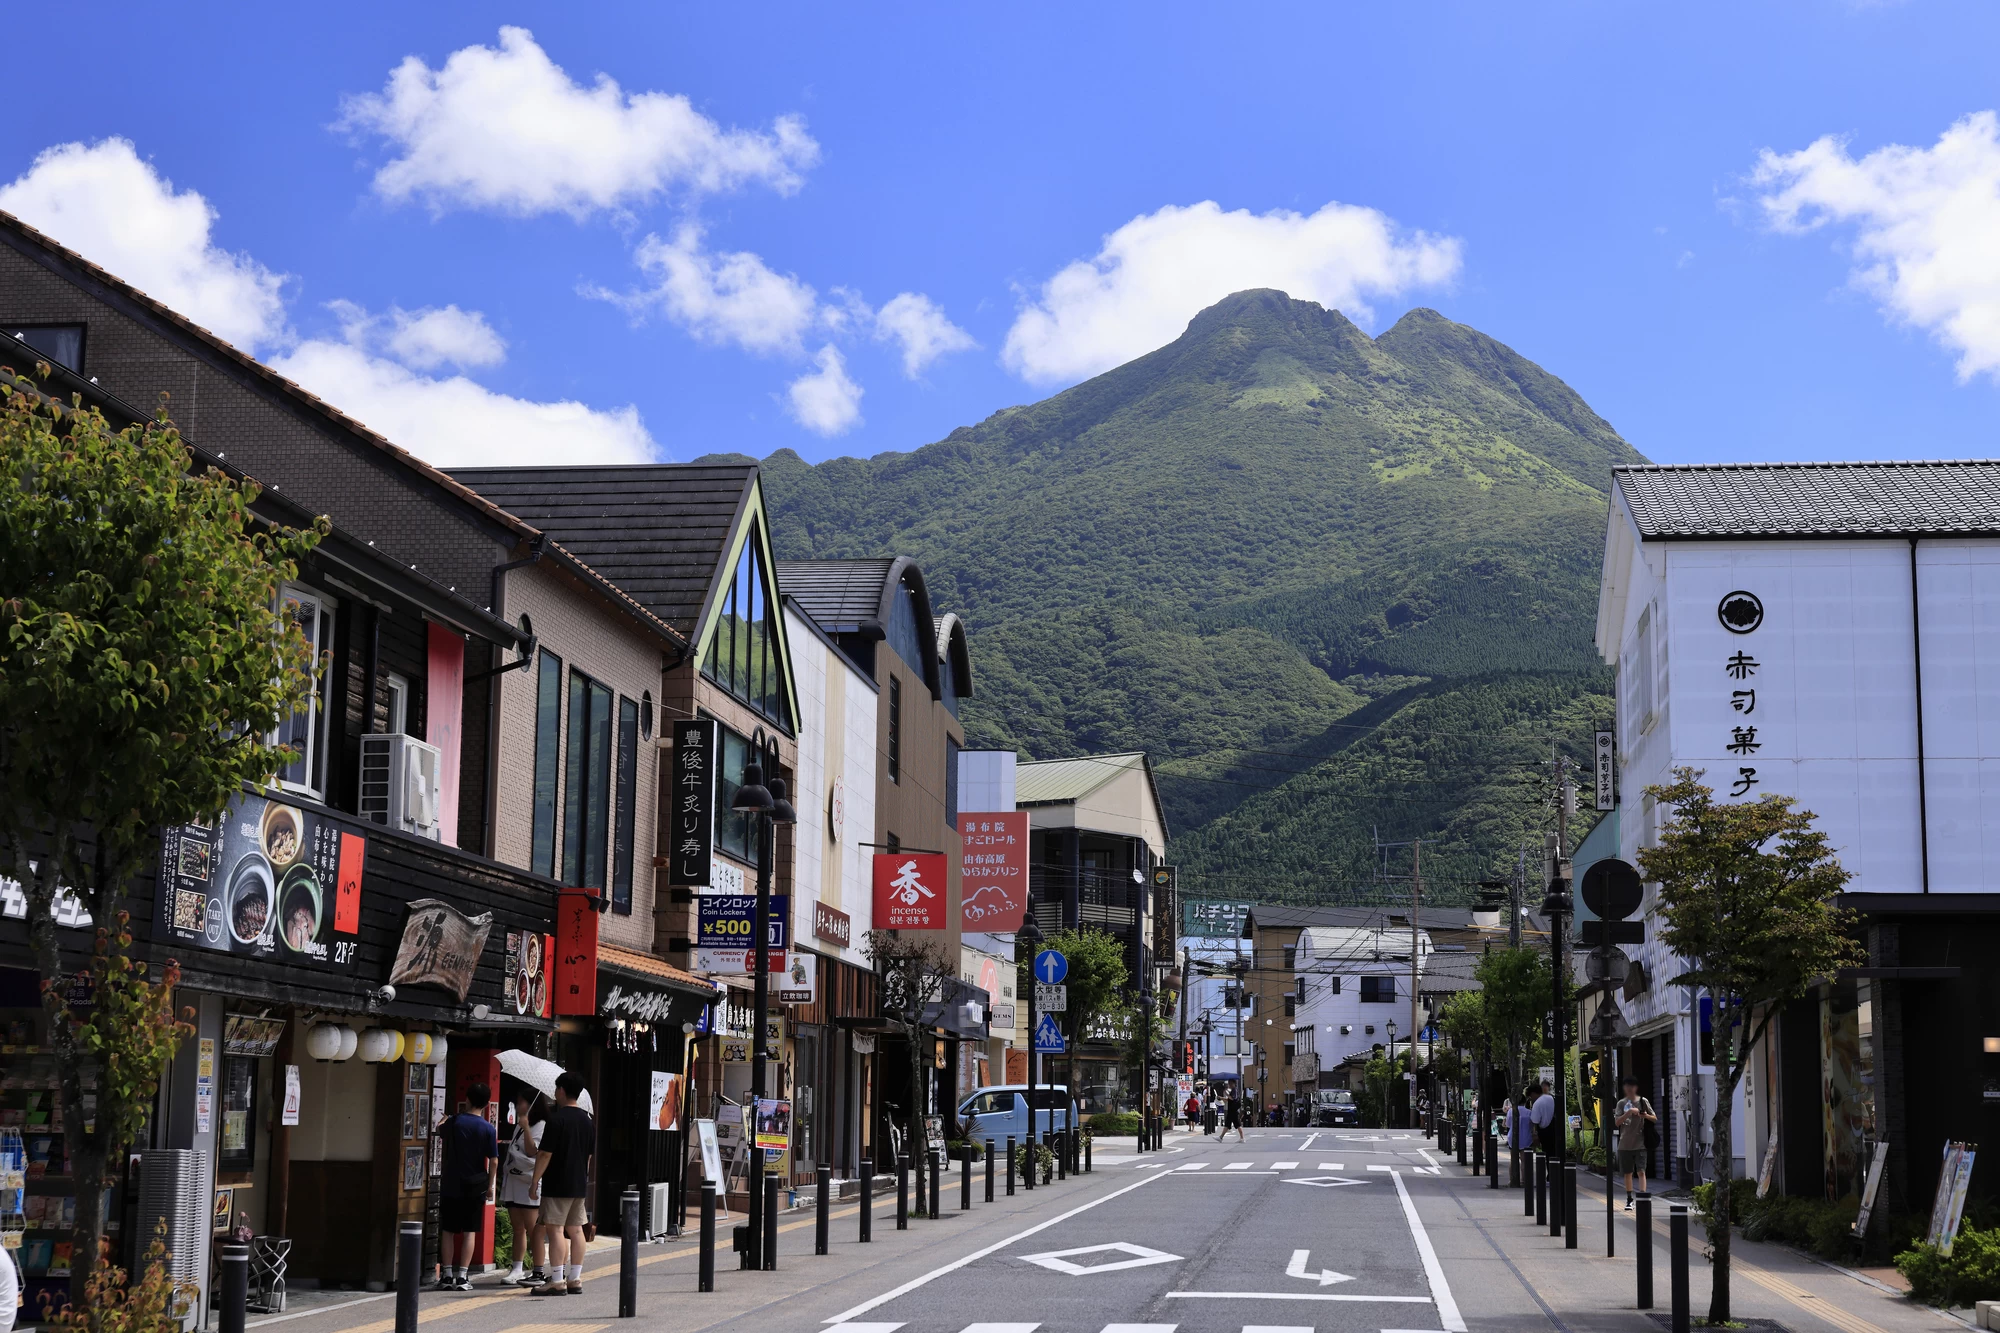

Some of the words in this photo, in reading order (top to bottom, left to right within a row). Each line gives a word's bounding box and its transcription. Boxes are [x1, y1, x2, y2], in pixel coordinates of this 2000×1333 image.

[1725, 649, 1763, 797] 赤司菓子
[680, 729, 704, 878] 豊後牛炙り寿し
[965, 822, 1005, 833] 湯布院
[964, 835, 1016, 846] まごロール
[319, 827, 330, 896] 心を味わう
[328, 829, 338, 884] 湯布院の
[964, 854, 1005, 865] 由布高原
[962, 867, 1019, 877] めらかプリン
[889, 860, 936, 905] 香
[702, 897, 772, 908] コインロッカ
[208, 909, 222, 921] TAKE
[891, 906, 928, 915] incense
[964, 900, 1018, 922] ゆふふ
[1193, 903, 1250, 919] パチンコ
[889, 916, 903, 925] 일본
[906, 916, 920, 925] 전통
[922, 916, 930, 925] 향
[208, 925, 220, 935] OUT
[703, 920, 751, 935] ¥500
[335, 941, 347, 964] 2F
[1036, 985, 1062, 994] 大型等
